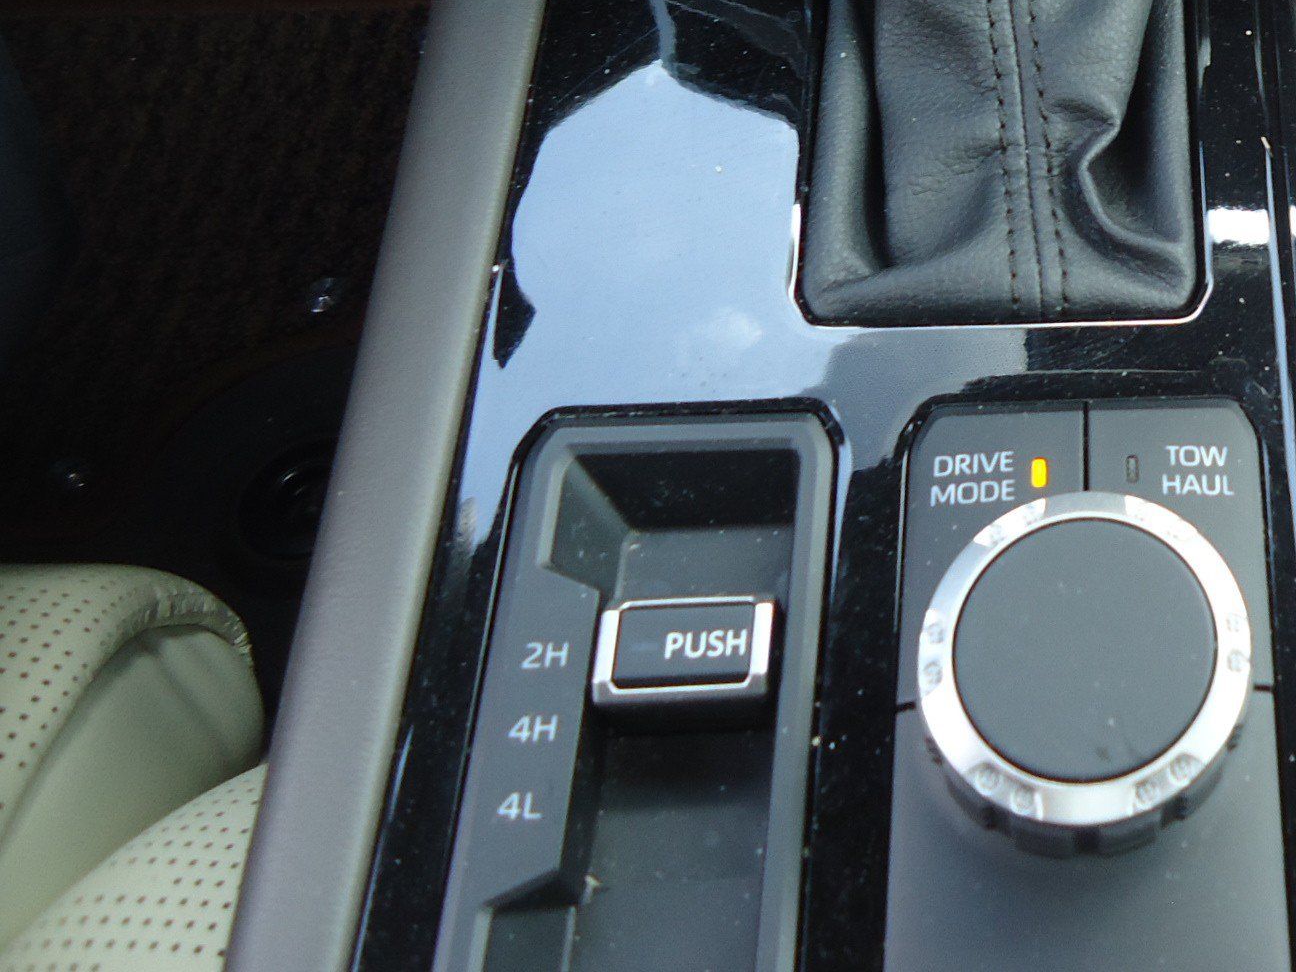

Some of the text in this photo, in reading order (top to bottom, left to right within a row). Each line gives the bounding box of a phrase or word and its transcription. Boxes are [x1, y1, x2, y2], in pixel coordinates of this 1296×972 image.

[933, 450, 1015, 478] DRIVE
[1166, 445, 1228, 467] TOW
[930, 479, 1016, 507] MODE
[1162, 474, 1234, 496] HAUL
[520, 642, 570, 670] 2H
[664, 628, 749, 660] PUSH
[508, 715, 559, 743] 4H
[496, 792, 543, 820] 4L
